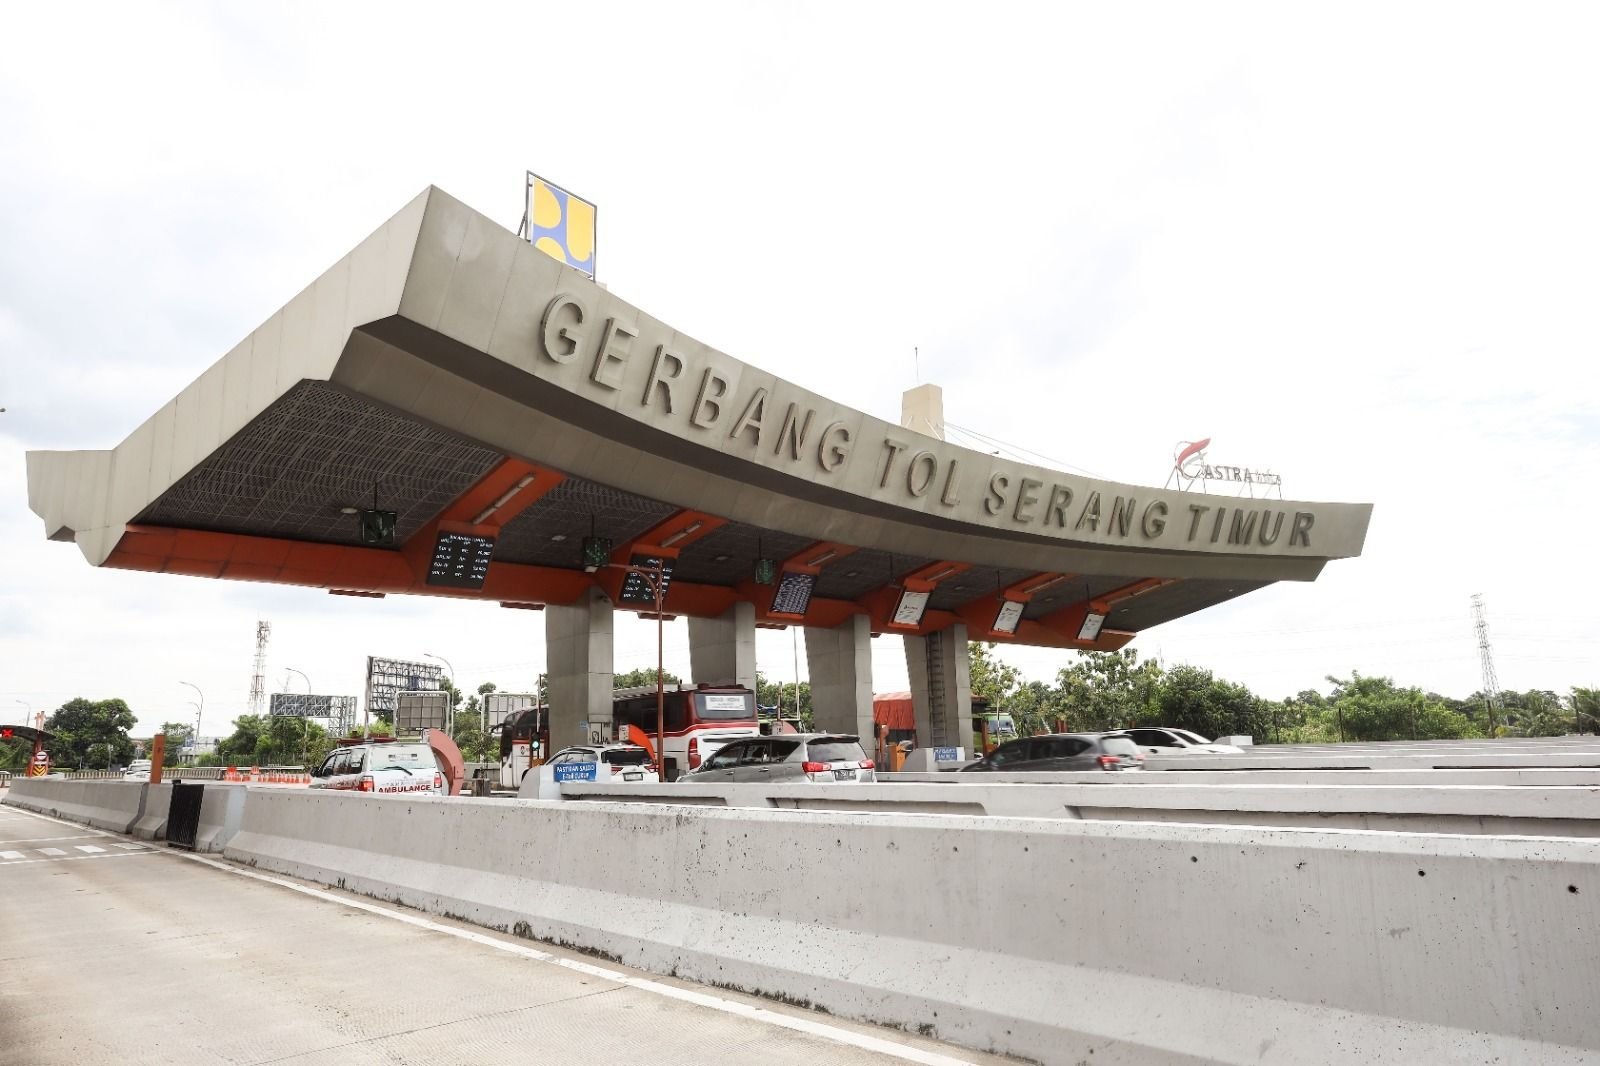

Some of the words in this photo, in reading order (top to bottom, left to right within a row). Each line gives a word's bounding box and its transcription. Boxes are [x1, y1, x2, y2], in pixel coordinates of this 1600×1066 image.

[541, 293, 852, 473] GERBANG
[881, 438, 961, 507] TOL
[985, 472, 1169, 538] SERANG
[1187, 504, 1316, 547] TIMUR
[1204, 464, 1253, 483] ASTRA
[378, 784, 432, 793] AMBULANCE
